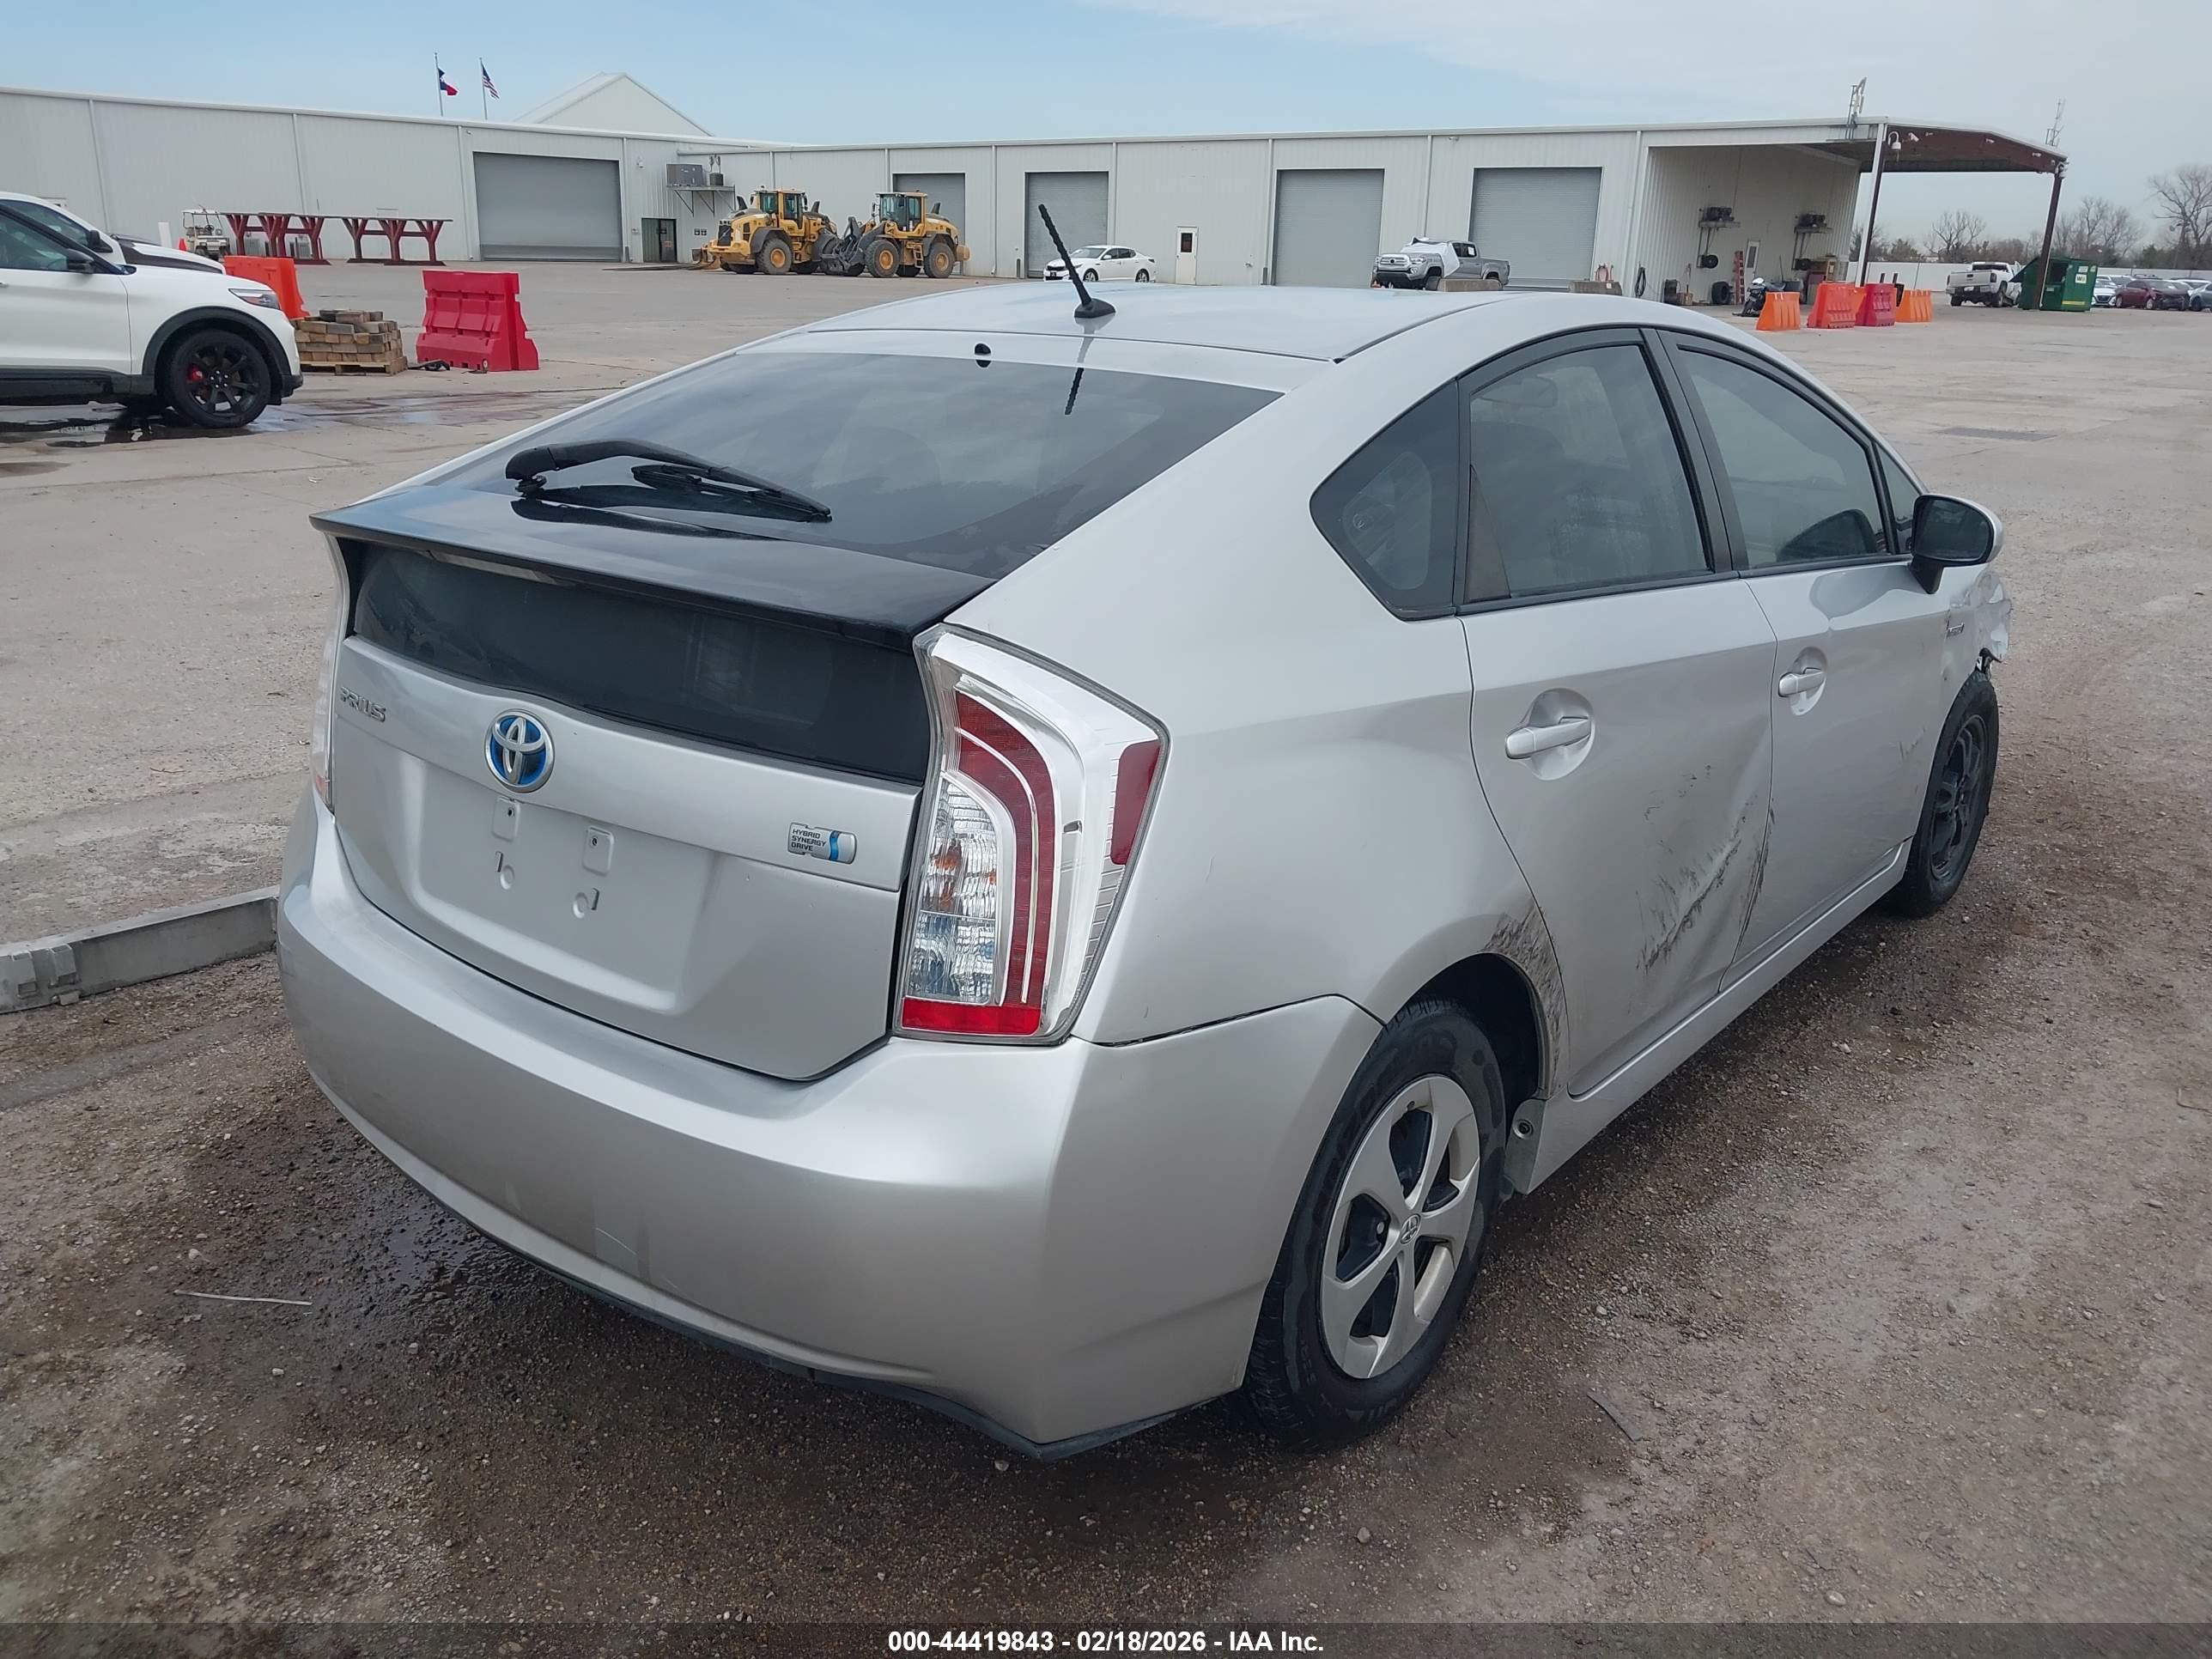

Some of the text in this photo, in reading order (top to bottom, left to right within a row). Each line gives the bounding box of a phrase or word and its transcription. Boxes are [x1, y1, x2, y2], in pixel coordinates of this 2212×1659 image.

[341, 686, 386, 722] PRIUS
[793, 829, 821, 839] HYBRID
[791, 842, 813, 851] DRIVE
[792, 835, 826, 848] SYNERGY
